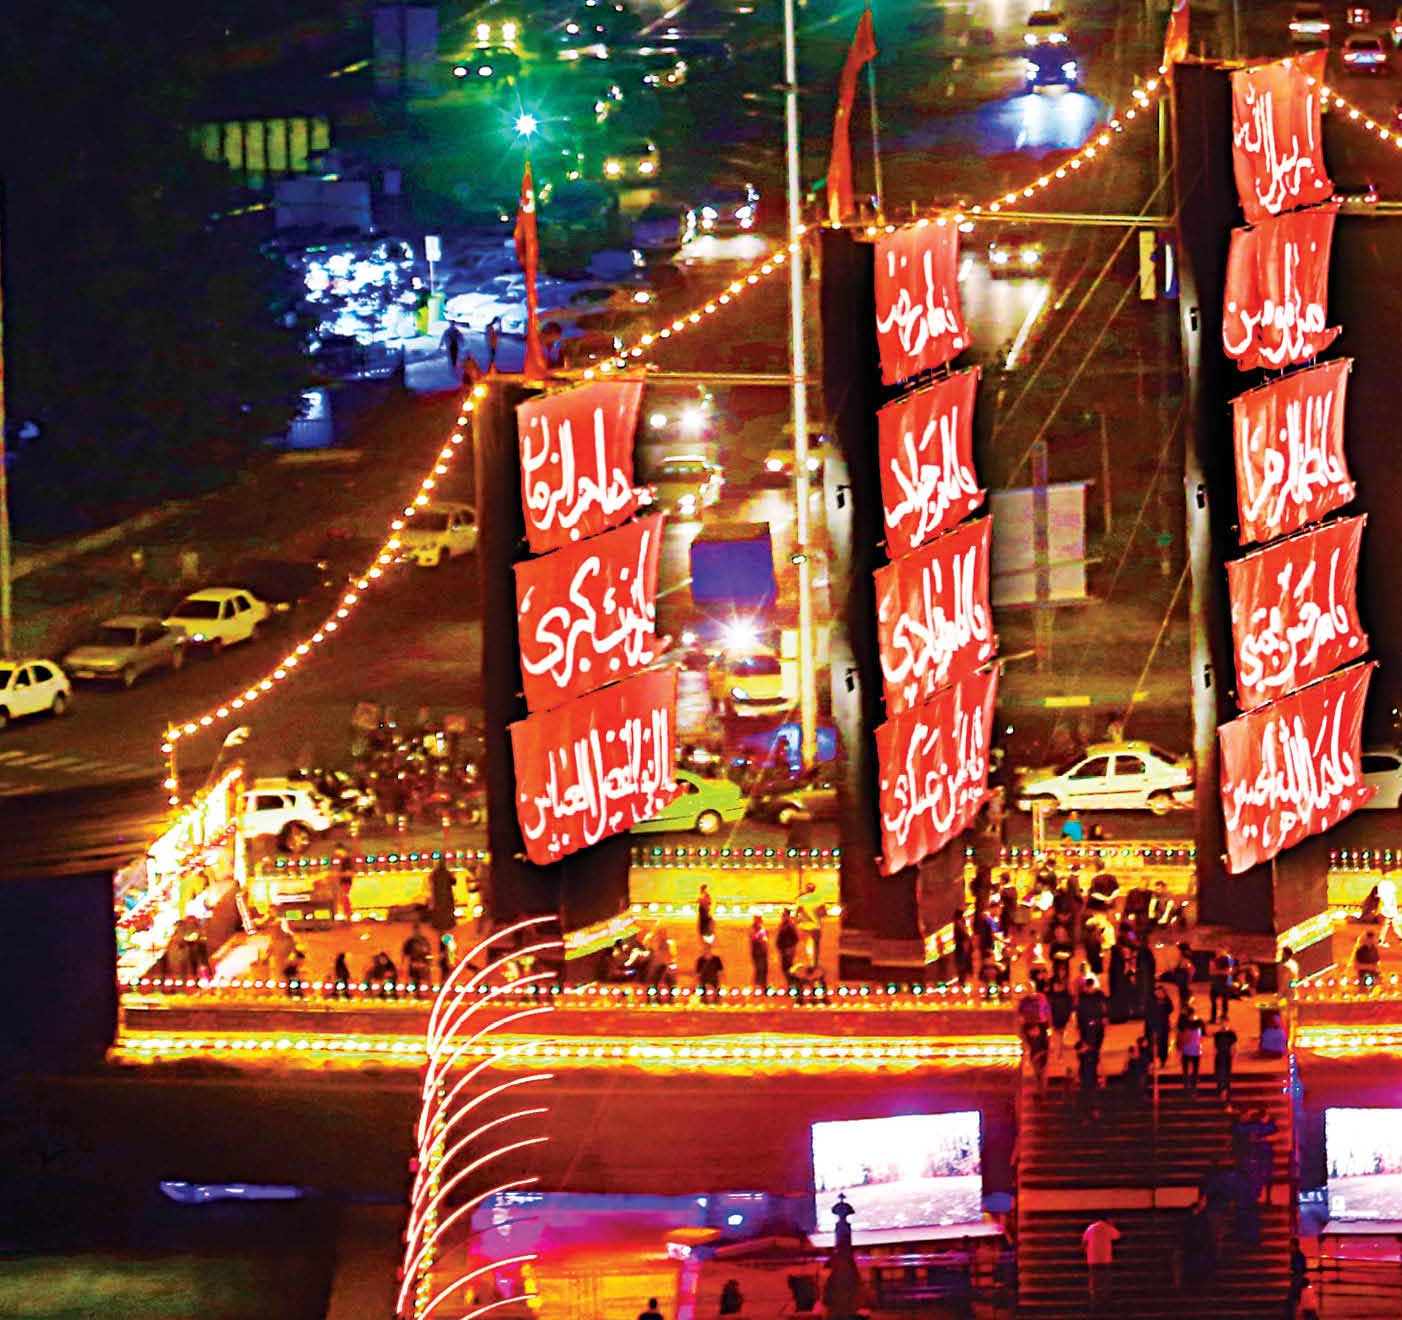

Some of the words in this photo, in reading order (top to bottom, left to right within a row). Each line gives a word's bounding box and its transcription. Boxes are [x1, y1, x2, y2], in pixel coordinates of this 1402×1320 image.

[523, 415, 574, 529] الزمان
[558, 407, 632, 540] صاحب
[524, 739, 601, 846] العباس
